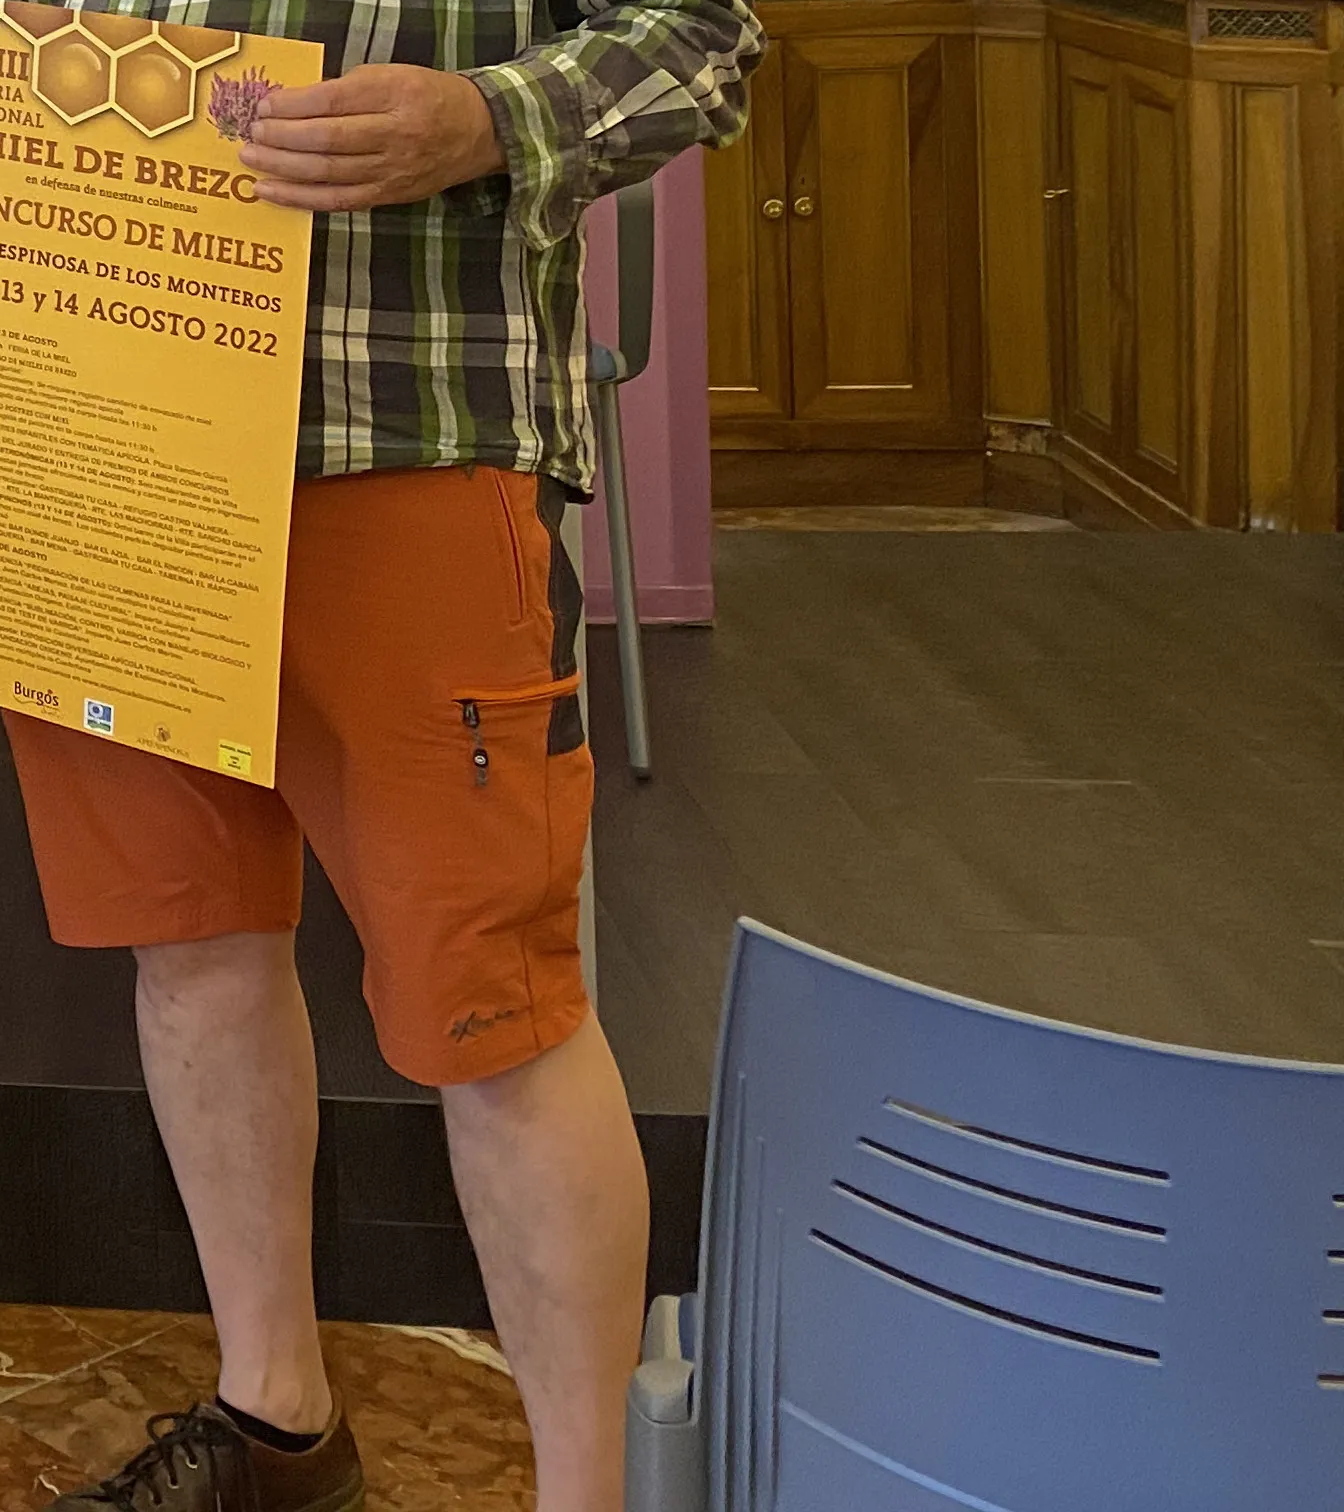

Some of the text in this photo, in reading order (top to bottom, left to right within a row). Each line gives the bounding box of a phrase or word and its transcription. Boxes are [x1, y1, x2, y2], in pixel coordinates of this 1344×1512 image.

[73, 145, 124, 180] DE
[124, 218, 165, 251] DE
[171, 227, 283, 274] MIELES
[95, 262, 120, 281] DE
[126, 267, 161, 289] LOS
[167, 275, 281, 313] MONTEROS
[1, 279, 277, 357] 13 y 14 AGOSTO 2022
[14, 681, 59, 707] Burgos
